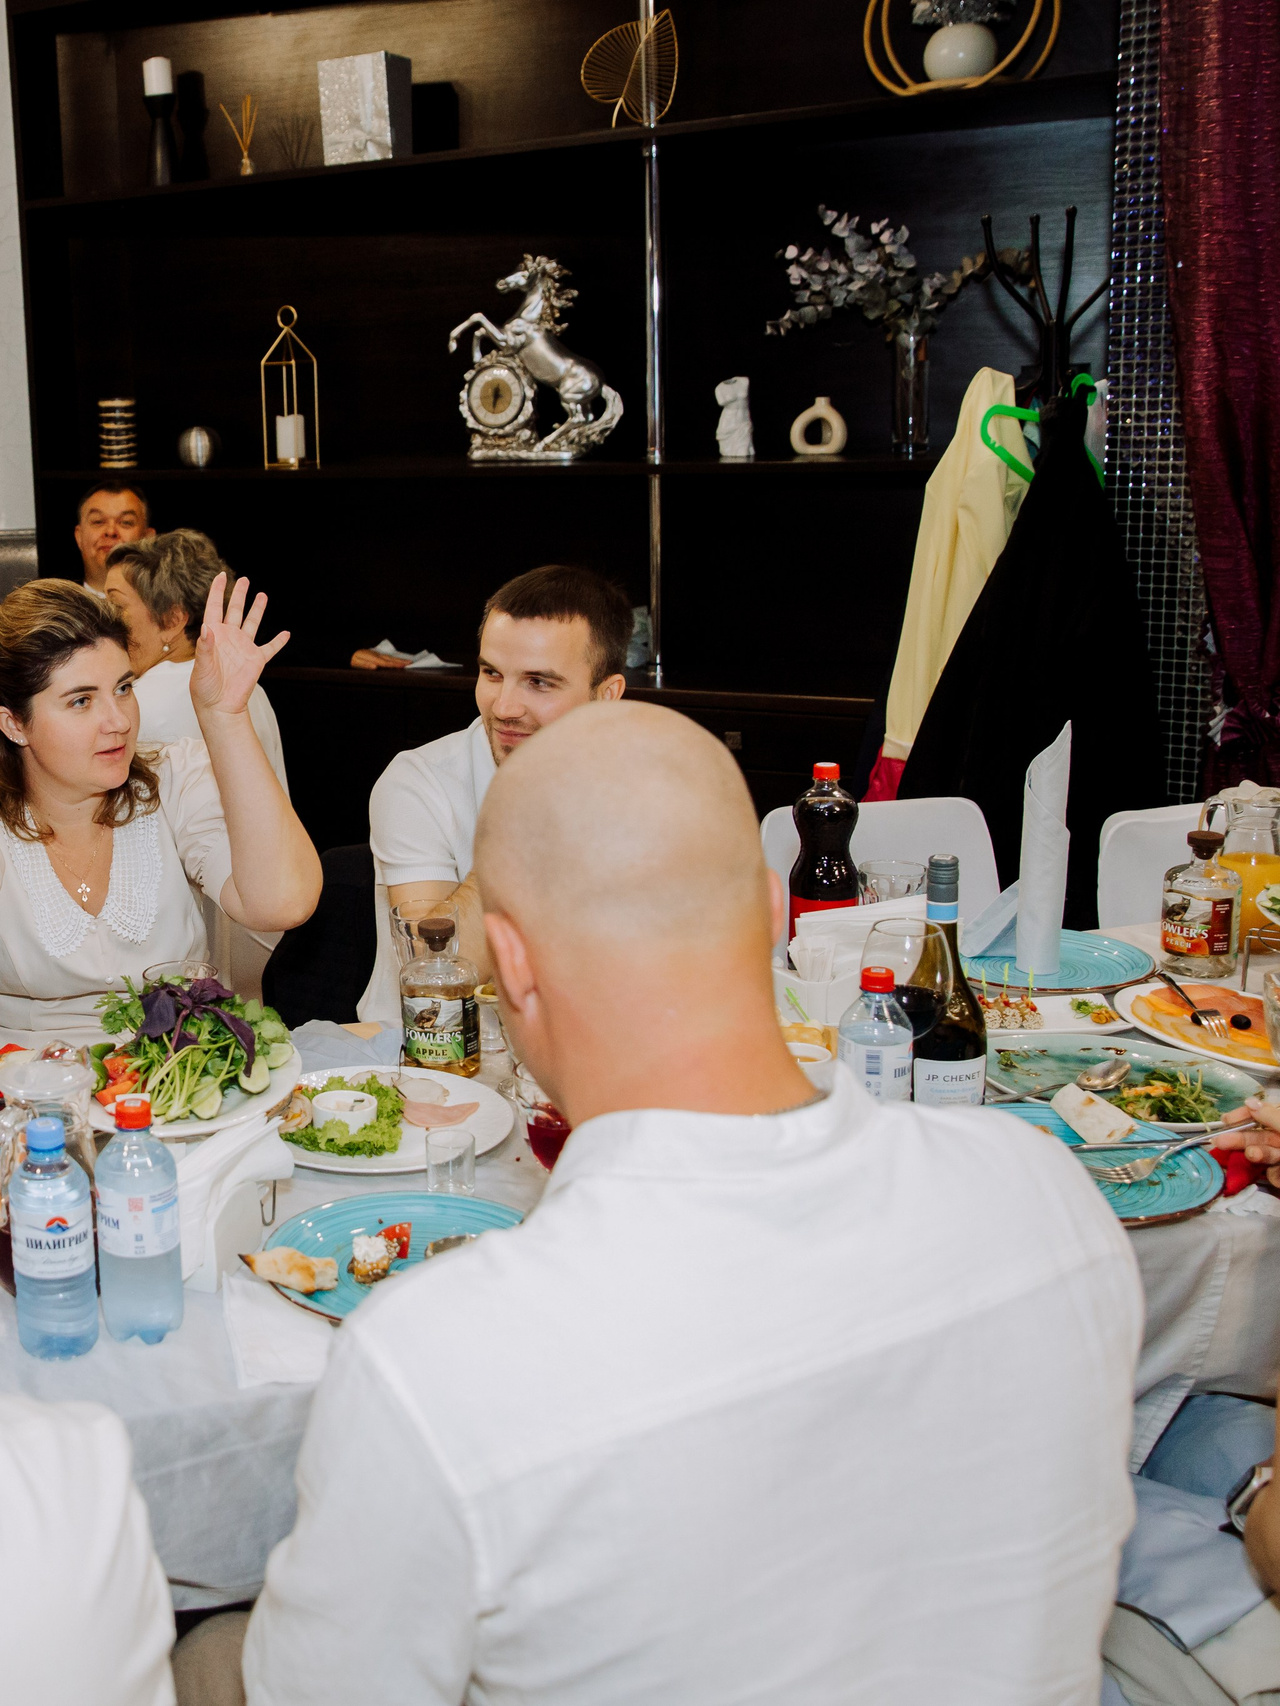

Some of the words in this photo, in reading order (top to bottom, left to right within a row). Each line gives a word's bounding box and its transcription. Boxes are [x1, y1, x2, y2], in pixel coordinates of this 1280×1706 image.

[1162, 921, 1209, 939] OWLER'S
[1166, 937, 1192, 949] PEACH
[405, 1028, 462, 1044] FOWLER'S
[416, 1047, 448, 1057] APPLE
[942, 1070, 981, 1083] CHENET
[26, 1229, 88, 1250] ПИЛИГРИМ
